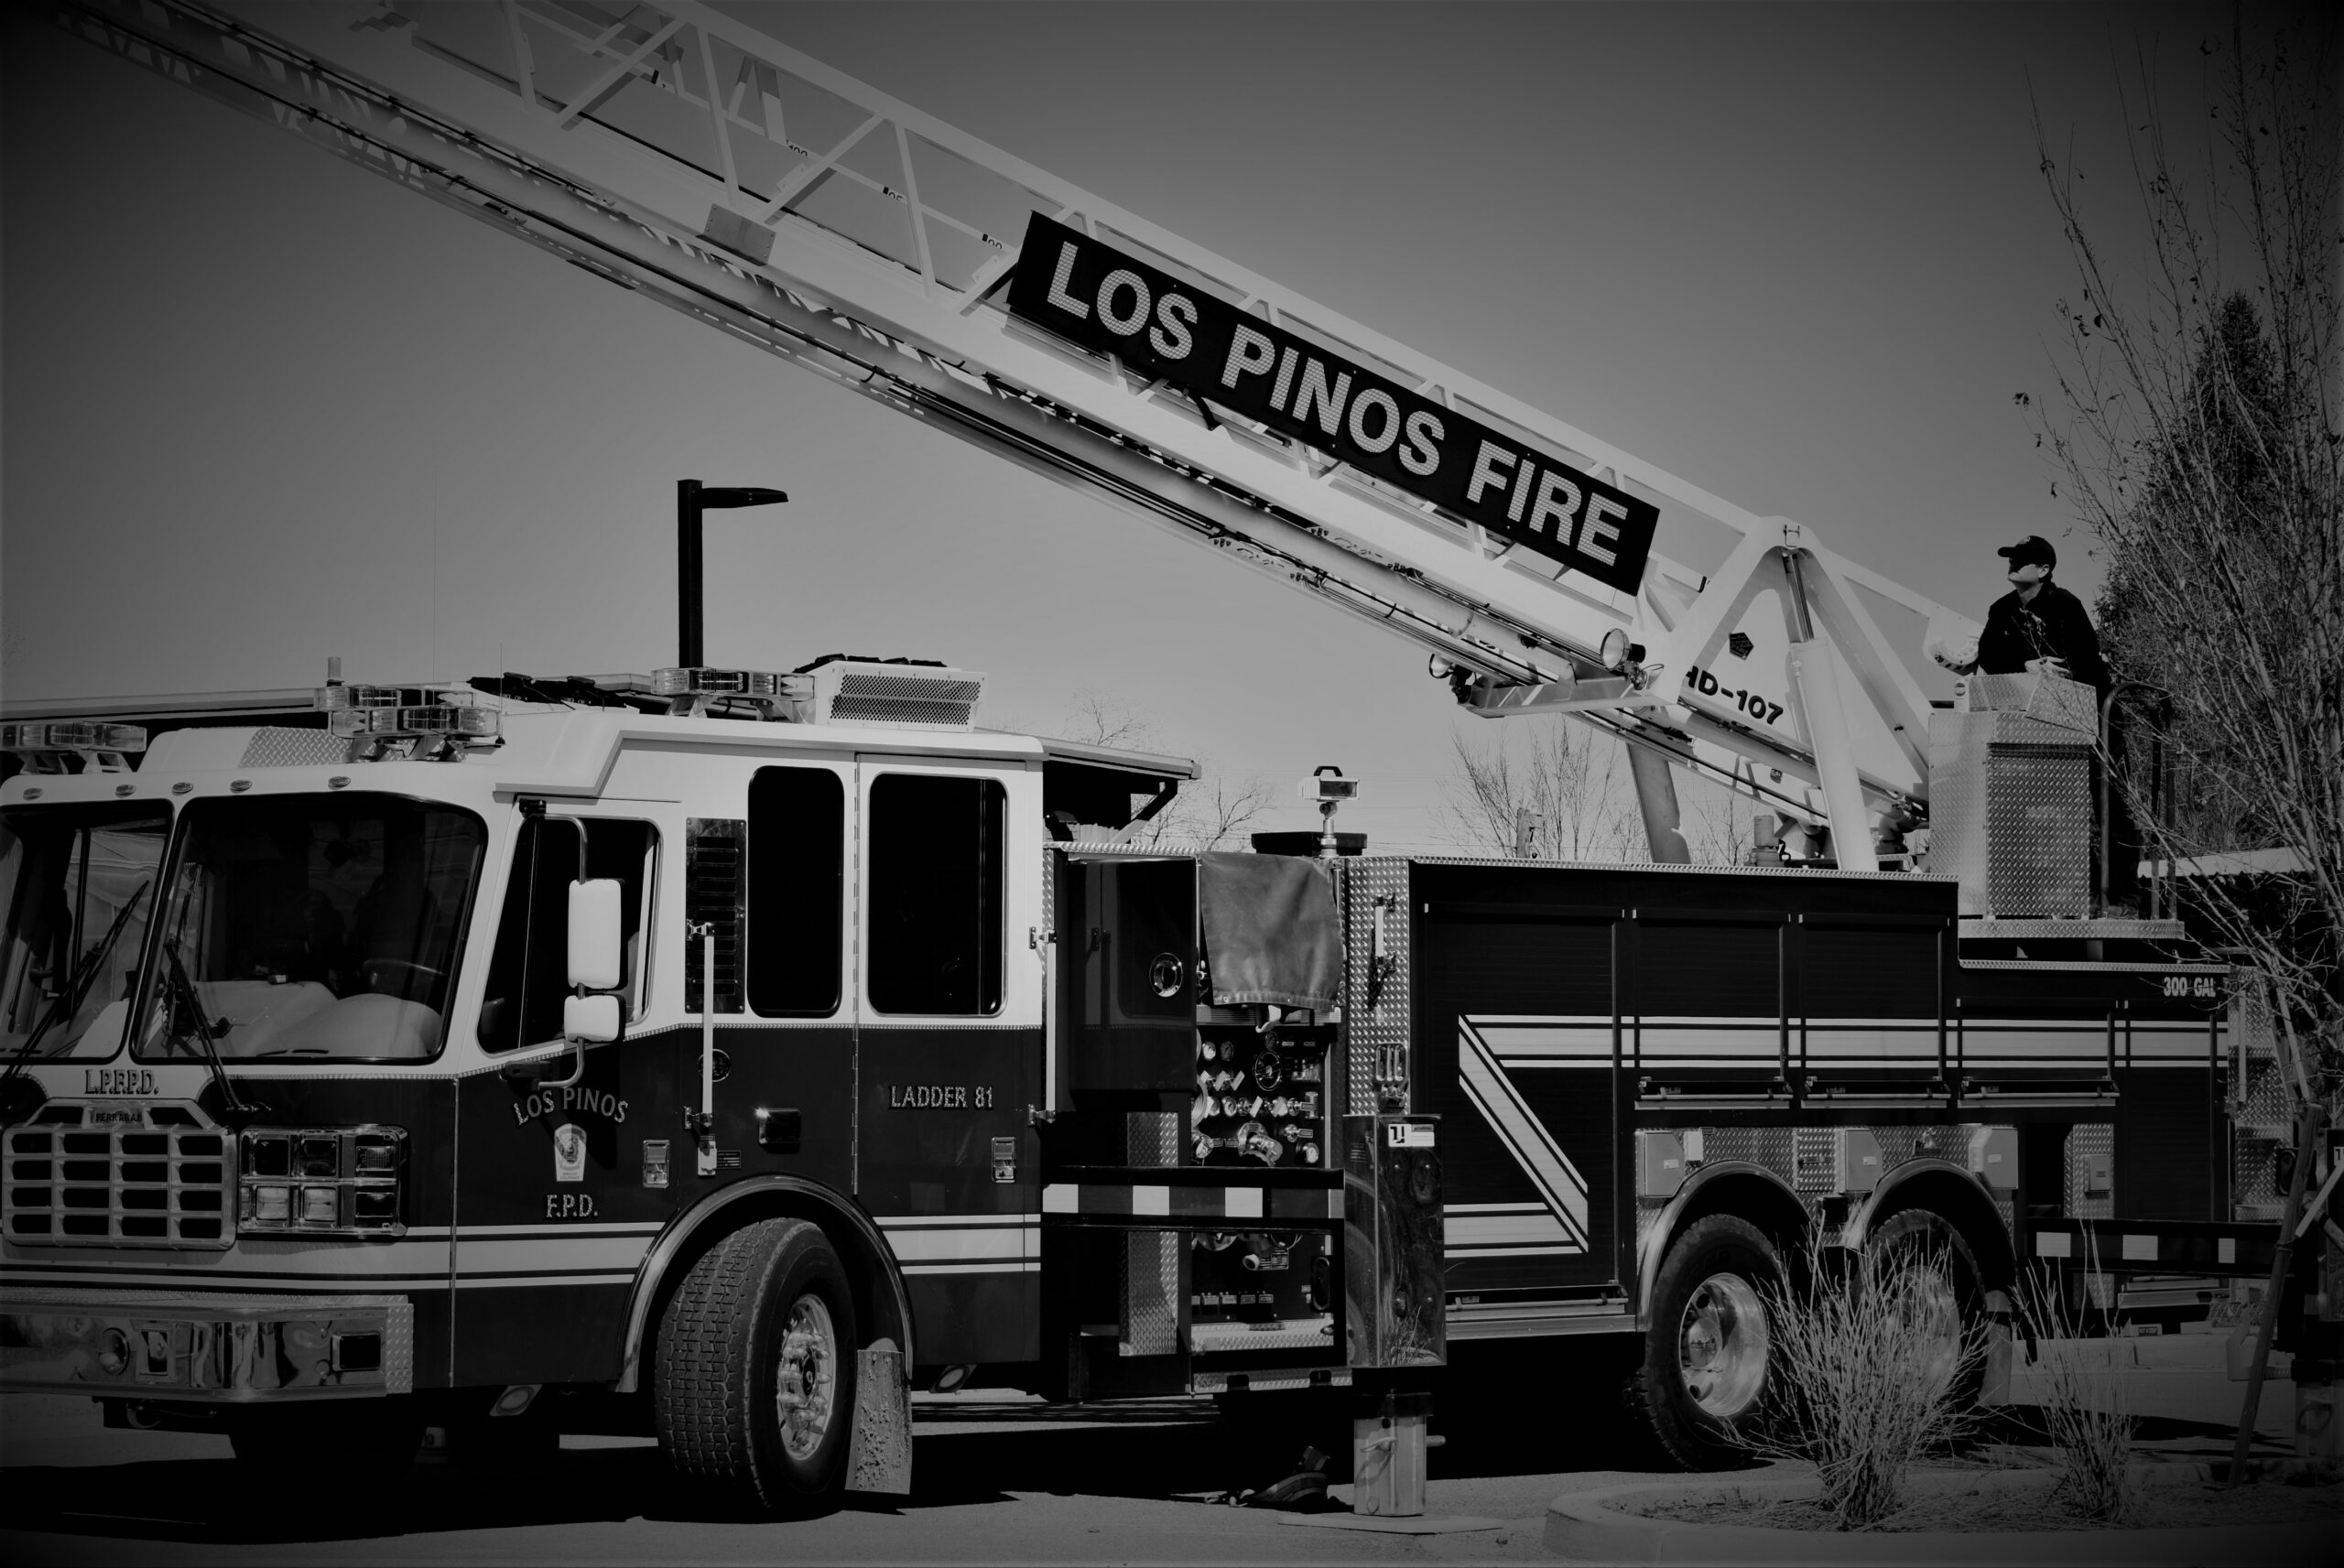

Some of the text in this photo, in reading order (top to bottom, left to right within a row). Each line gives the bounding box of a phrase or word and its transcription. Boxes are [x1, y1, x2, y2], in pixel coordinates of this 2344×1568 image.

[1047, 241, 1629, 567] LOS PINOS FIRE
[2162, 976, 2217, 998] 300 GAL
[513, 1086, 630, 1127] LOS PINOS
[890, 1085, 993, 1109] LADDER 81
[546, 1194, 599, 1218] F.P.D.
